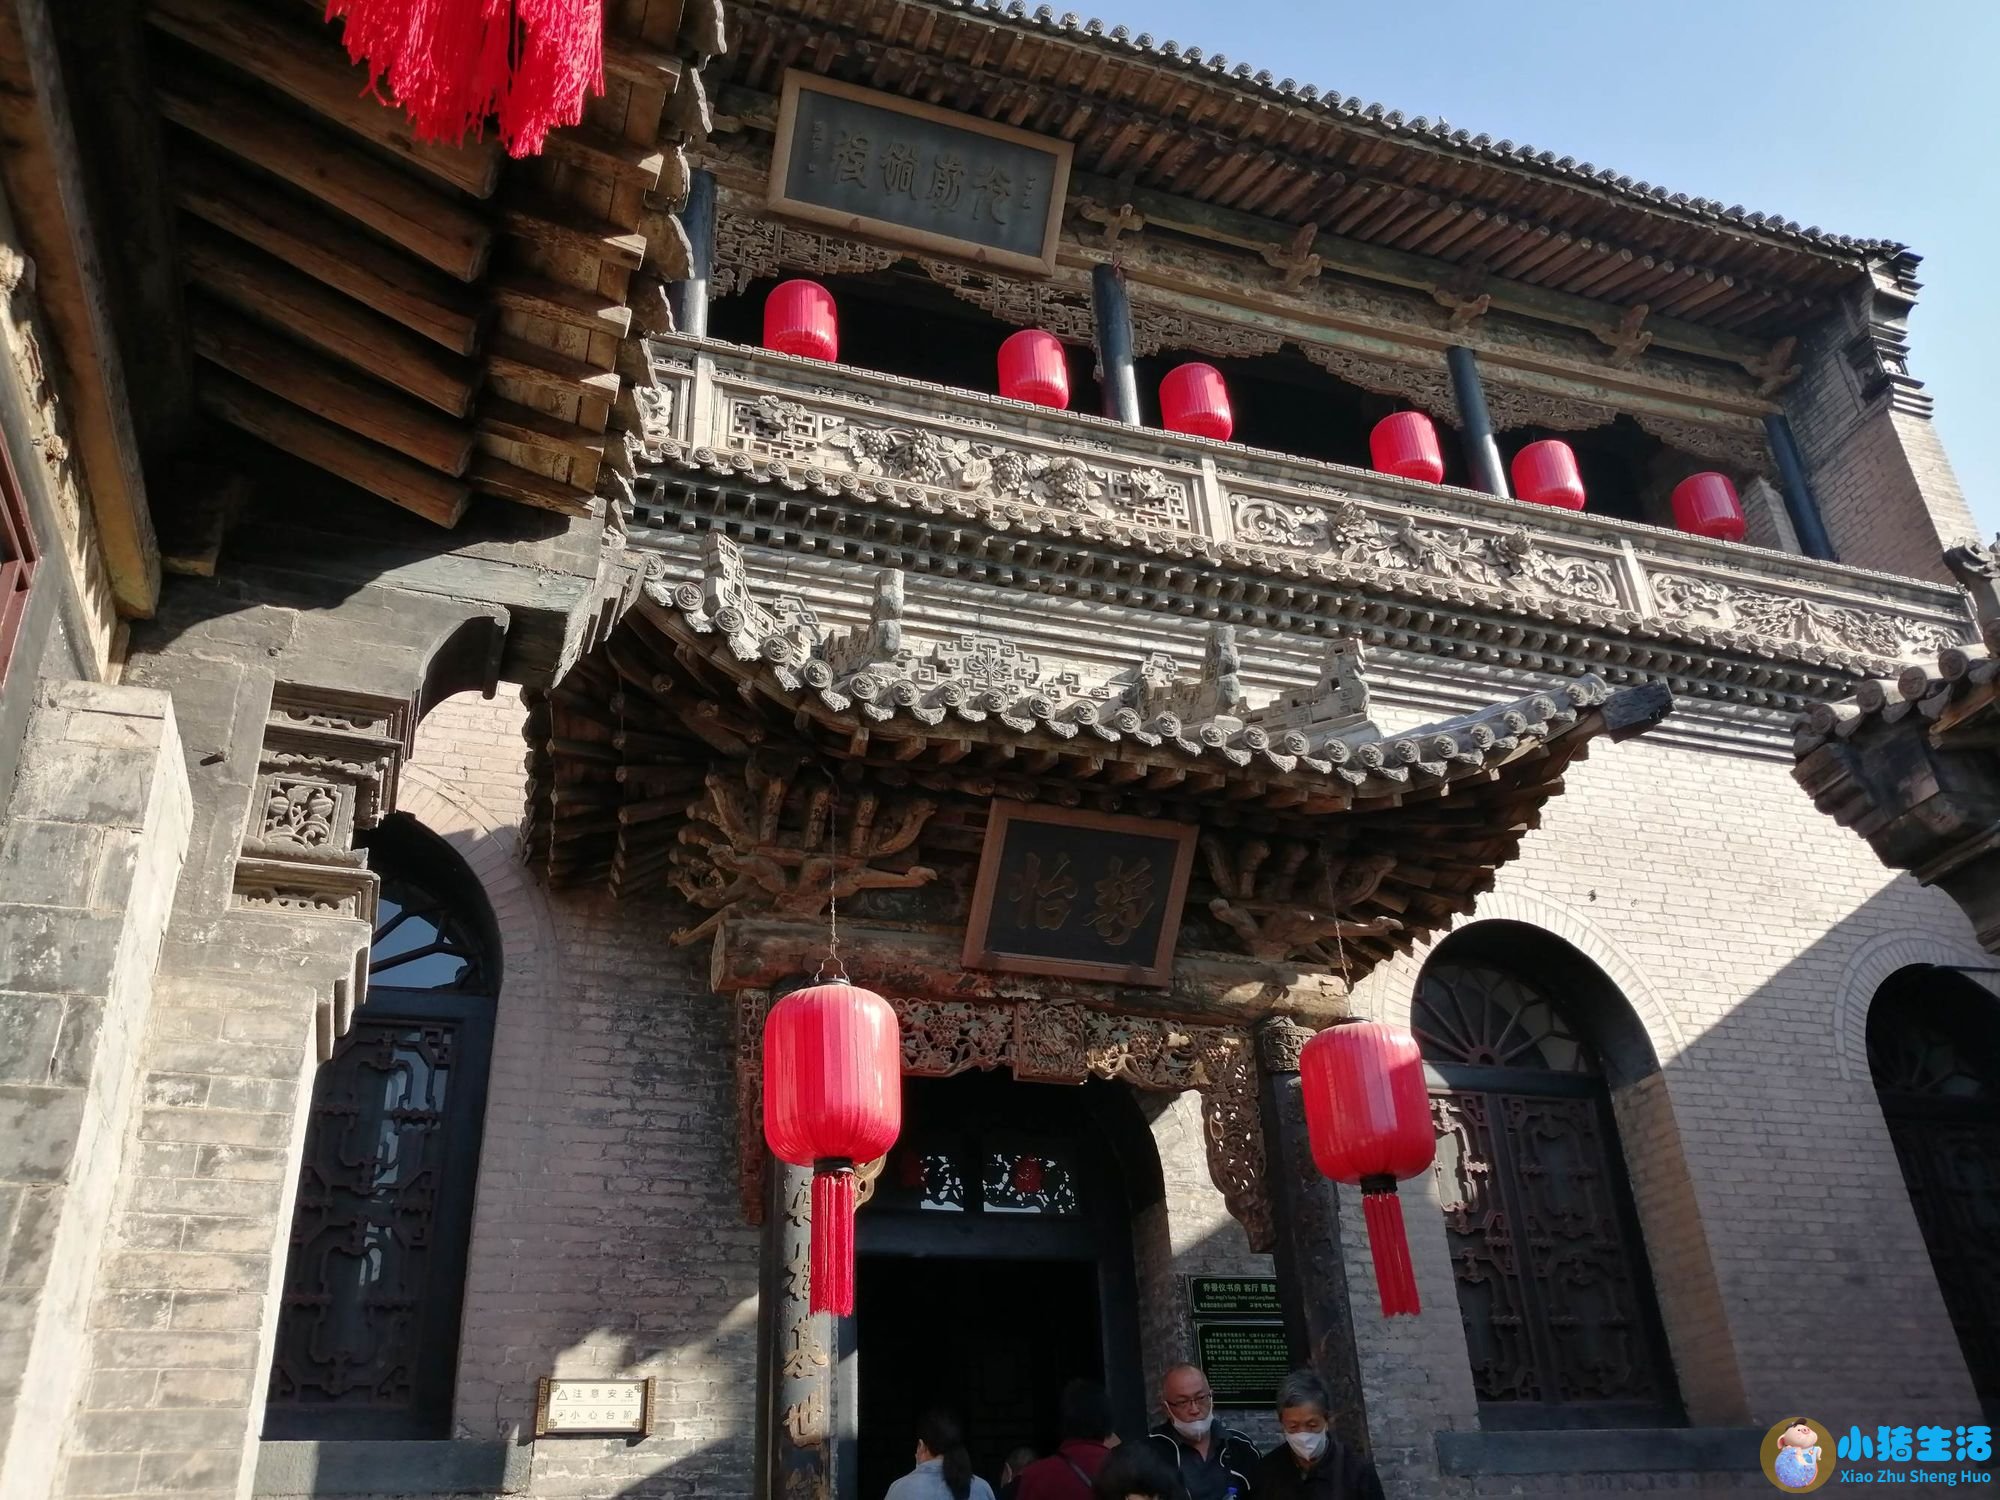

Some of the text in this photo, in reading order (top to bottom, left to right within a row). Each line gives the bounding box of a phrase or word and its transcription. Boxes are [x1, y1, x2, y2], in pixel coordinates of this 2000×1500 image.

[573, 1388, 634, 1399] 注意安全
[570, 1409, 632, 1420] 小心台阶
